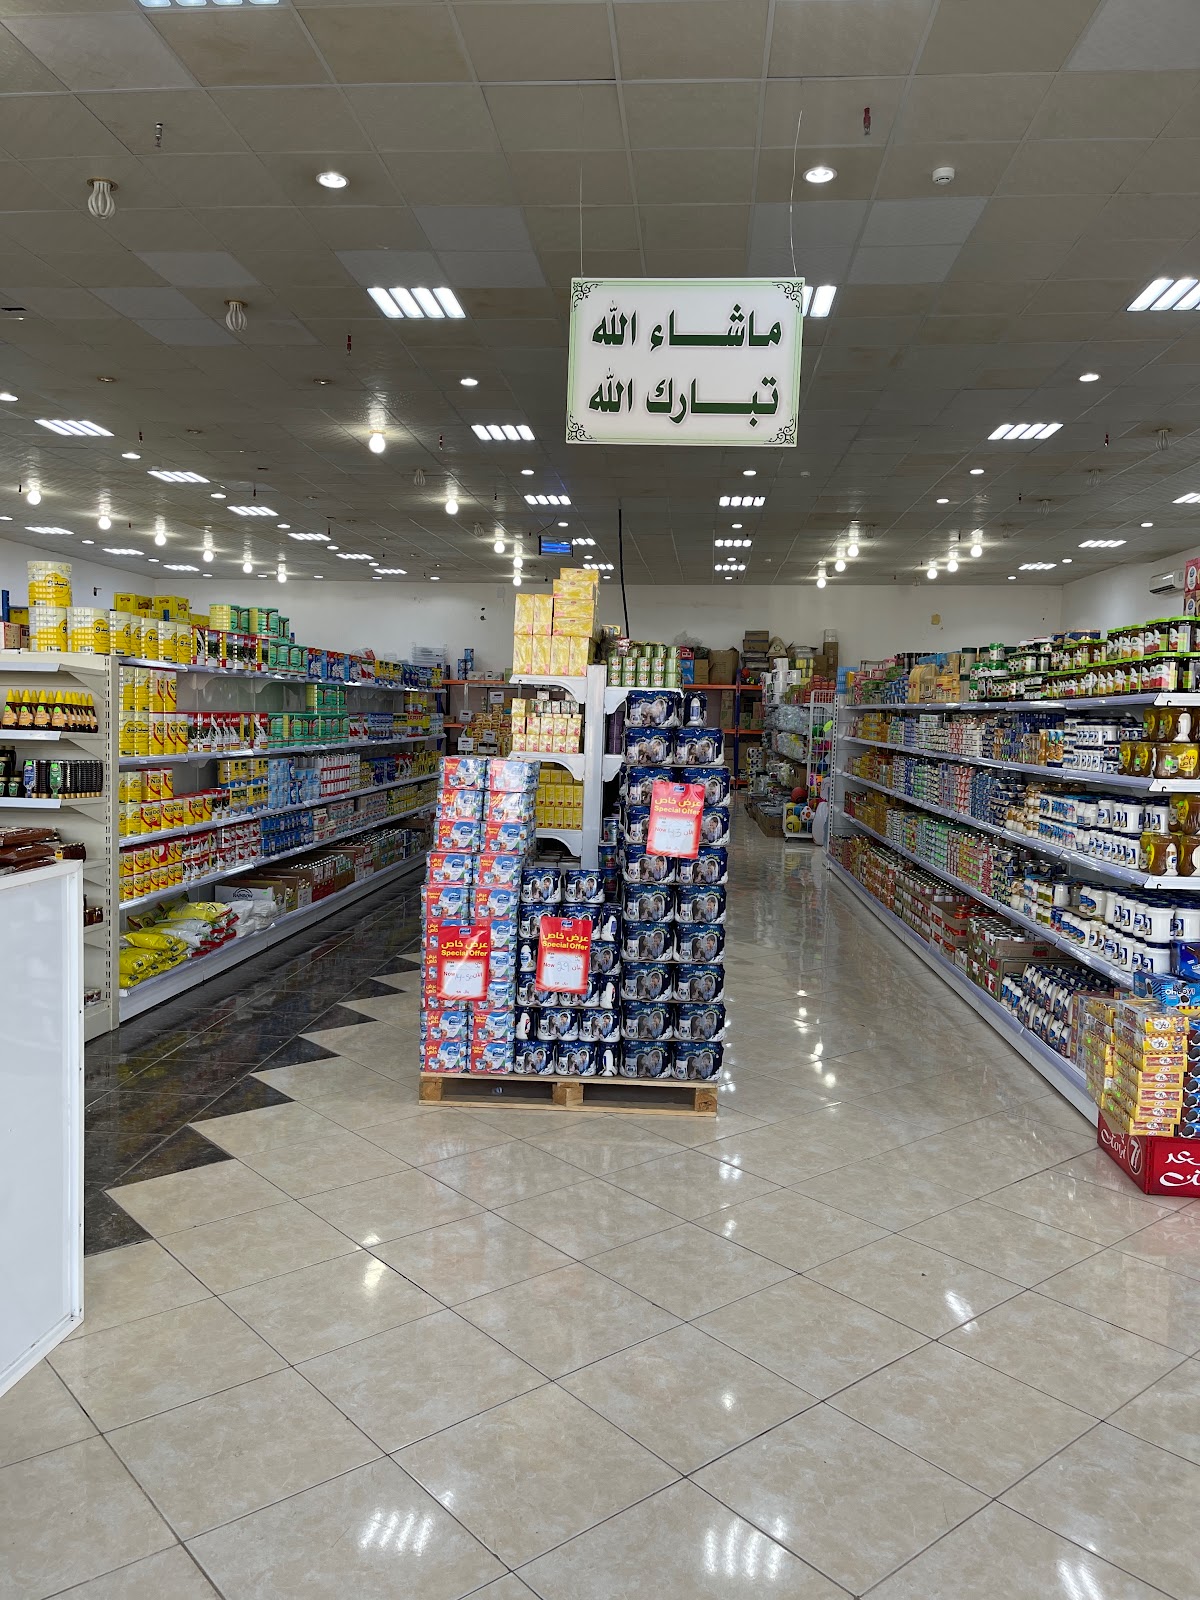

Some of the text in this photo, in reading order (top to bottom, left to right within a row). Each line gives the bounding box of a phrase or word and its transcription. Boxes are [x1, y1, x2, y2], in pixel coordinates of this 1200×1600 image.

[592, 300, 782, 351] ماشاء الله
[588, 367, 779, 427] تبارك الله
[655, 797, 701, 807] عرض خاص
[654, 805, 680, 813] Special
[542, 932, 588, 943] عرض خاص
[441, 940, 488, 950] عرض خاص
